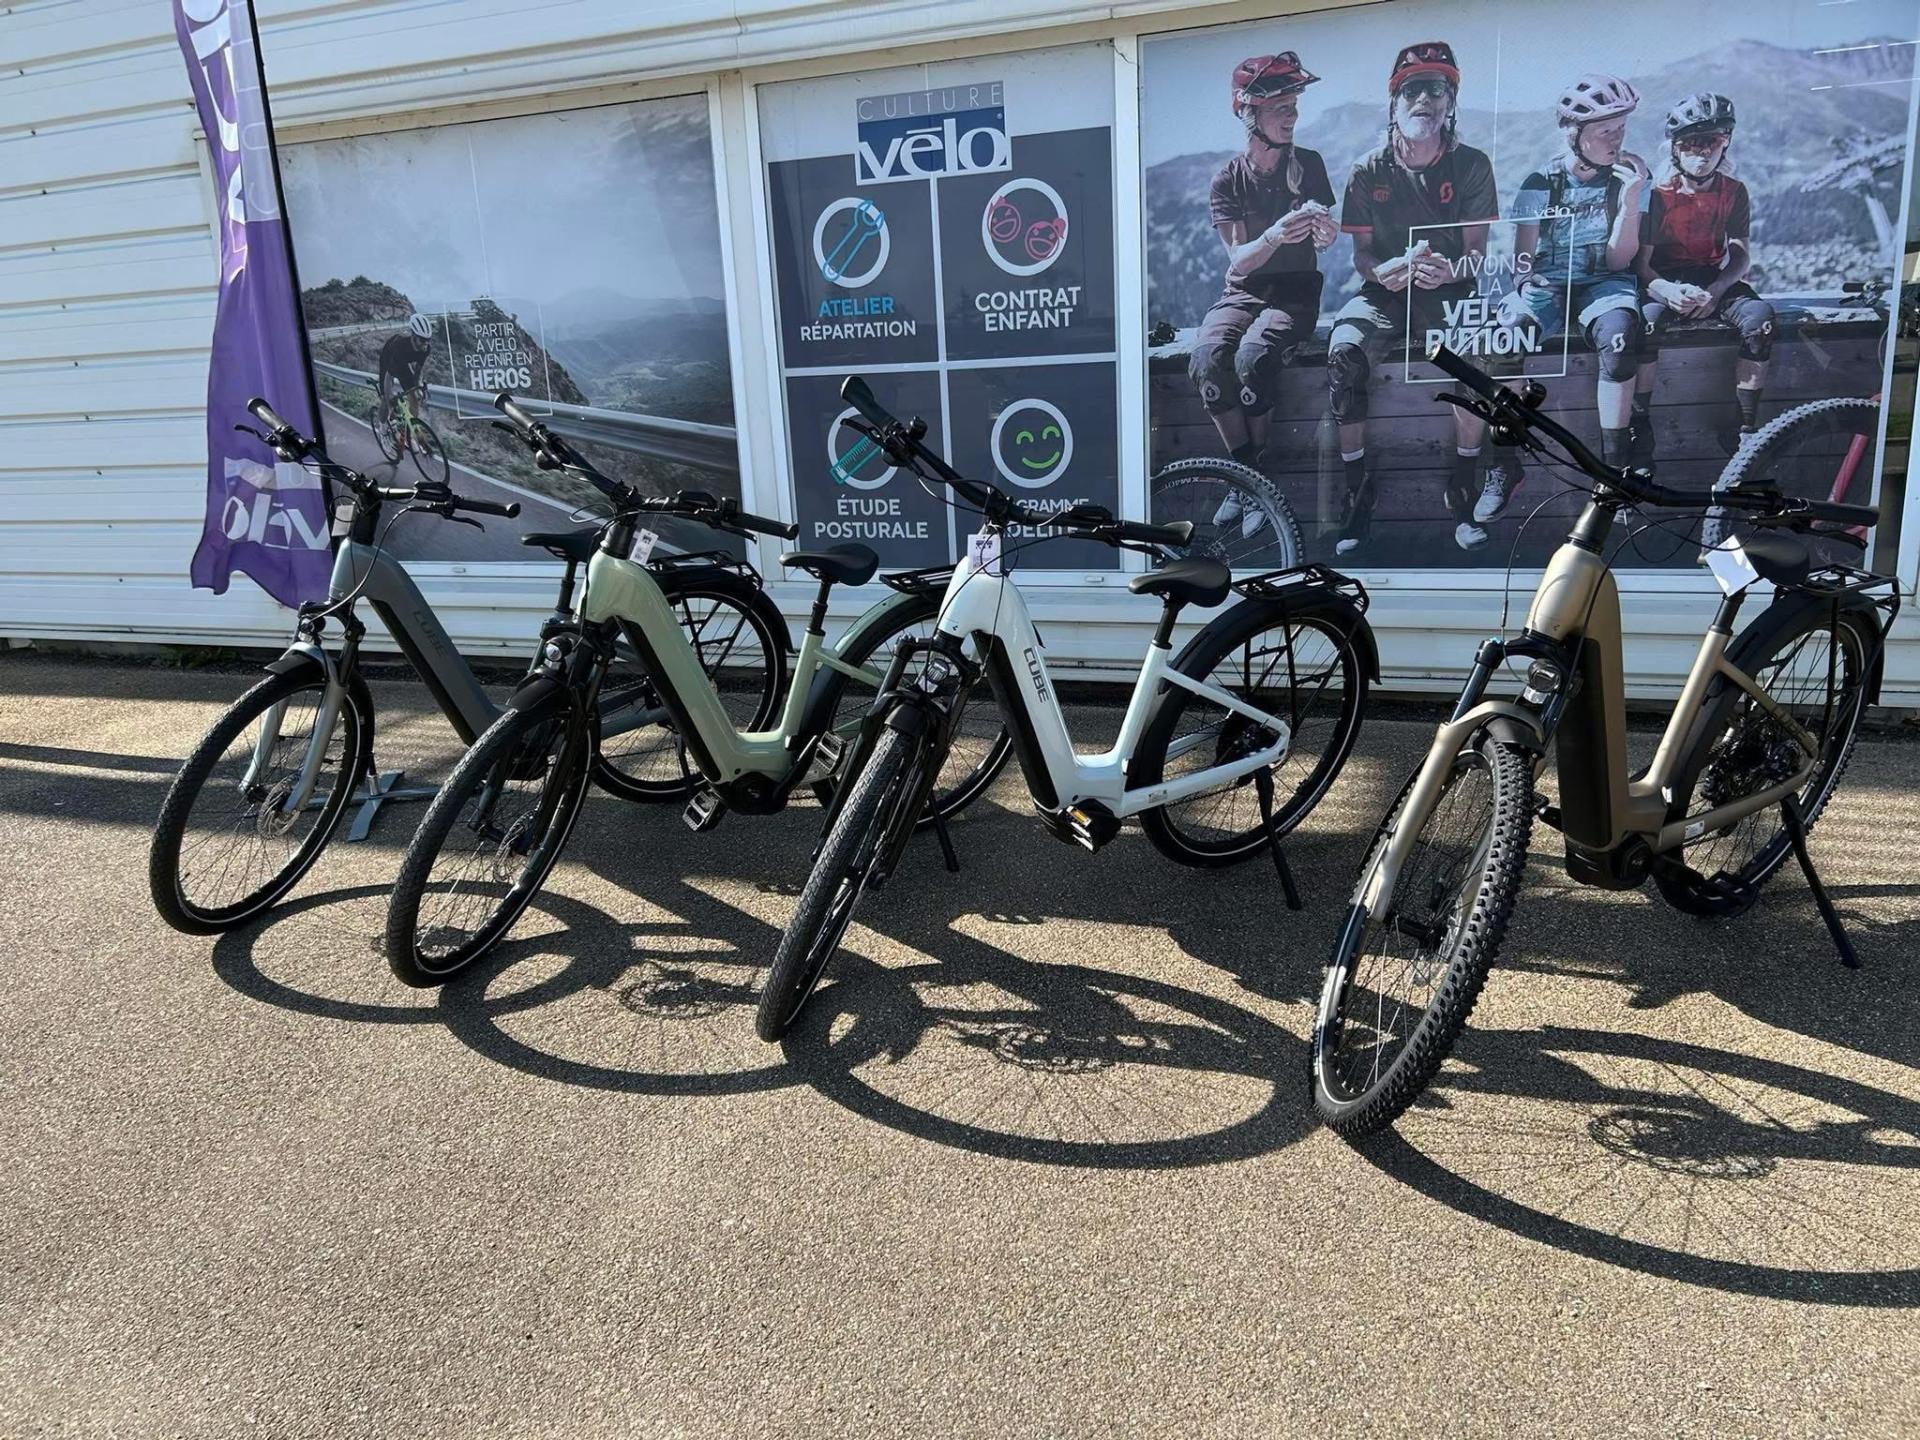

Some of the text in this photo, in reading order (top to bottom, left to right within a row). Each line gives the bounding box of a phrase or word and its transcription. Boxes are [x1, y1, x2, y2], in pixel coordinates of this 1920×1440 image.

[858, 84, 1001, 120] CULTURE
[1448, 252, 1532, 278] VIVONS
[1477, 279, 1503, 296] LA
[819, 297, 895, 317] ATELIER
[975, 286, 1081, 312] CONTRAT
[474, 322, 515, 338] PARTIR
[800, 320, 917, 341] RÉPARTATION
[985, 308, 1073, 332] ENFANT
[485, 337, 517, 352] VELO
[464, 352, 532, 368] REVENIR EN
[837, 494, 901, 516] ÉTUDE
[814, 522, 929, 539] POSTURALE
[1023, 648, 1049, 703] CUBE
